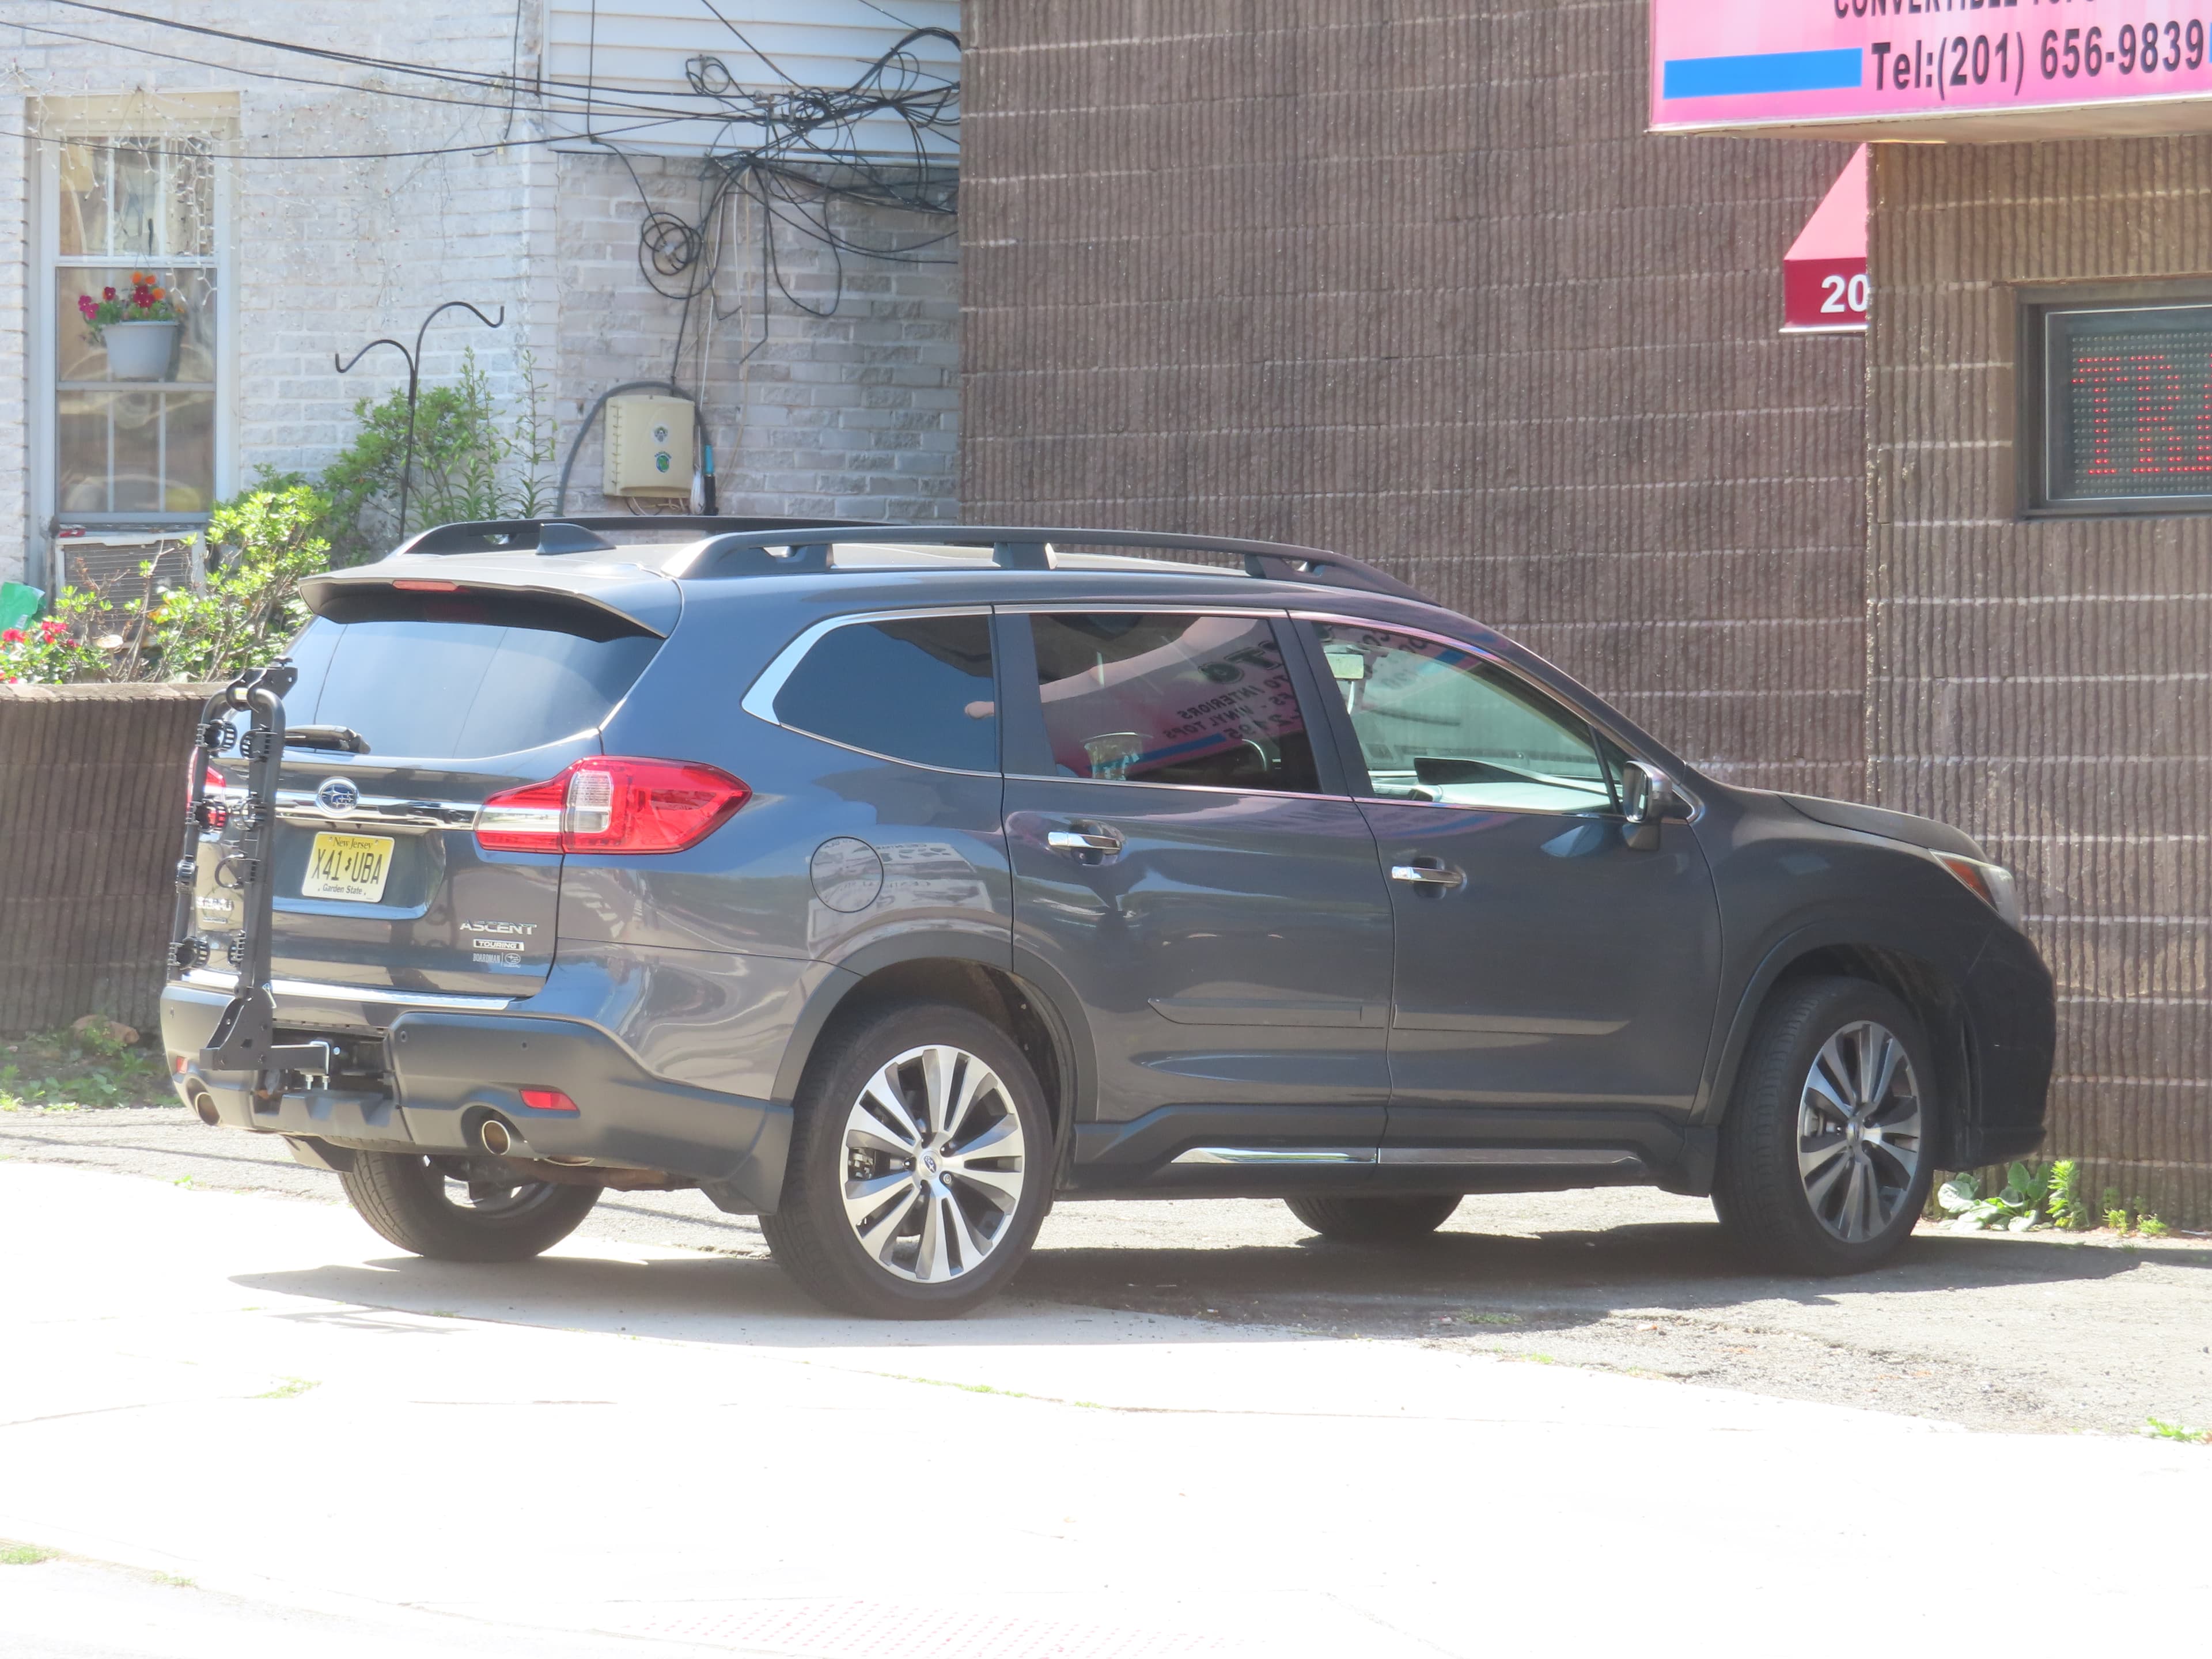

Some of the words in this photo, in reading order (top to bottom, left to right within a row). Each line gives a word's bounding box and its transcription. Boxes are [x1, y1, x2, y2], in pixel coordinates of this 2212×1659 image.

[1871, 32, 2024, 101] Tel:(201)
[2040, 18, 2204, 80] 656-9839
[1820, 274, 1870, 313] 20
[2072, 353, 2212, 475] TR
[332, 836, 349, 848] New
[349, 838, 373, 850] Jersey
[311, 849, 343, 881] X41
[351, 851, 382, 885] UBA
[323, 883, 344, 893] Garden
[346, 885, 363, 895] State
[460, 919, 537, 935] ASCENT
[478, 941, 517, 949] TOURING
